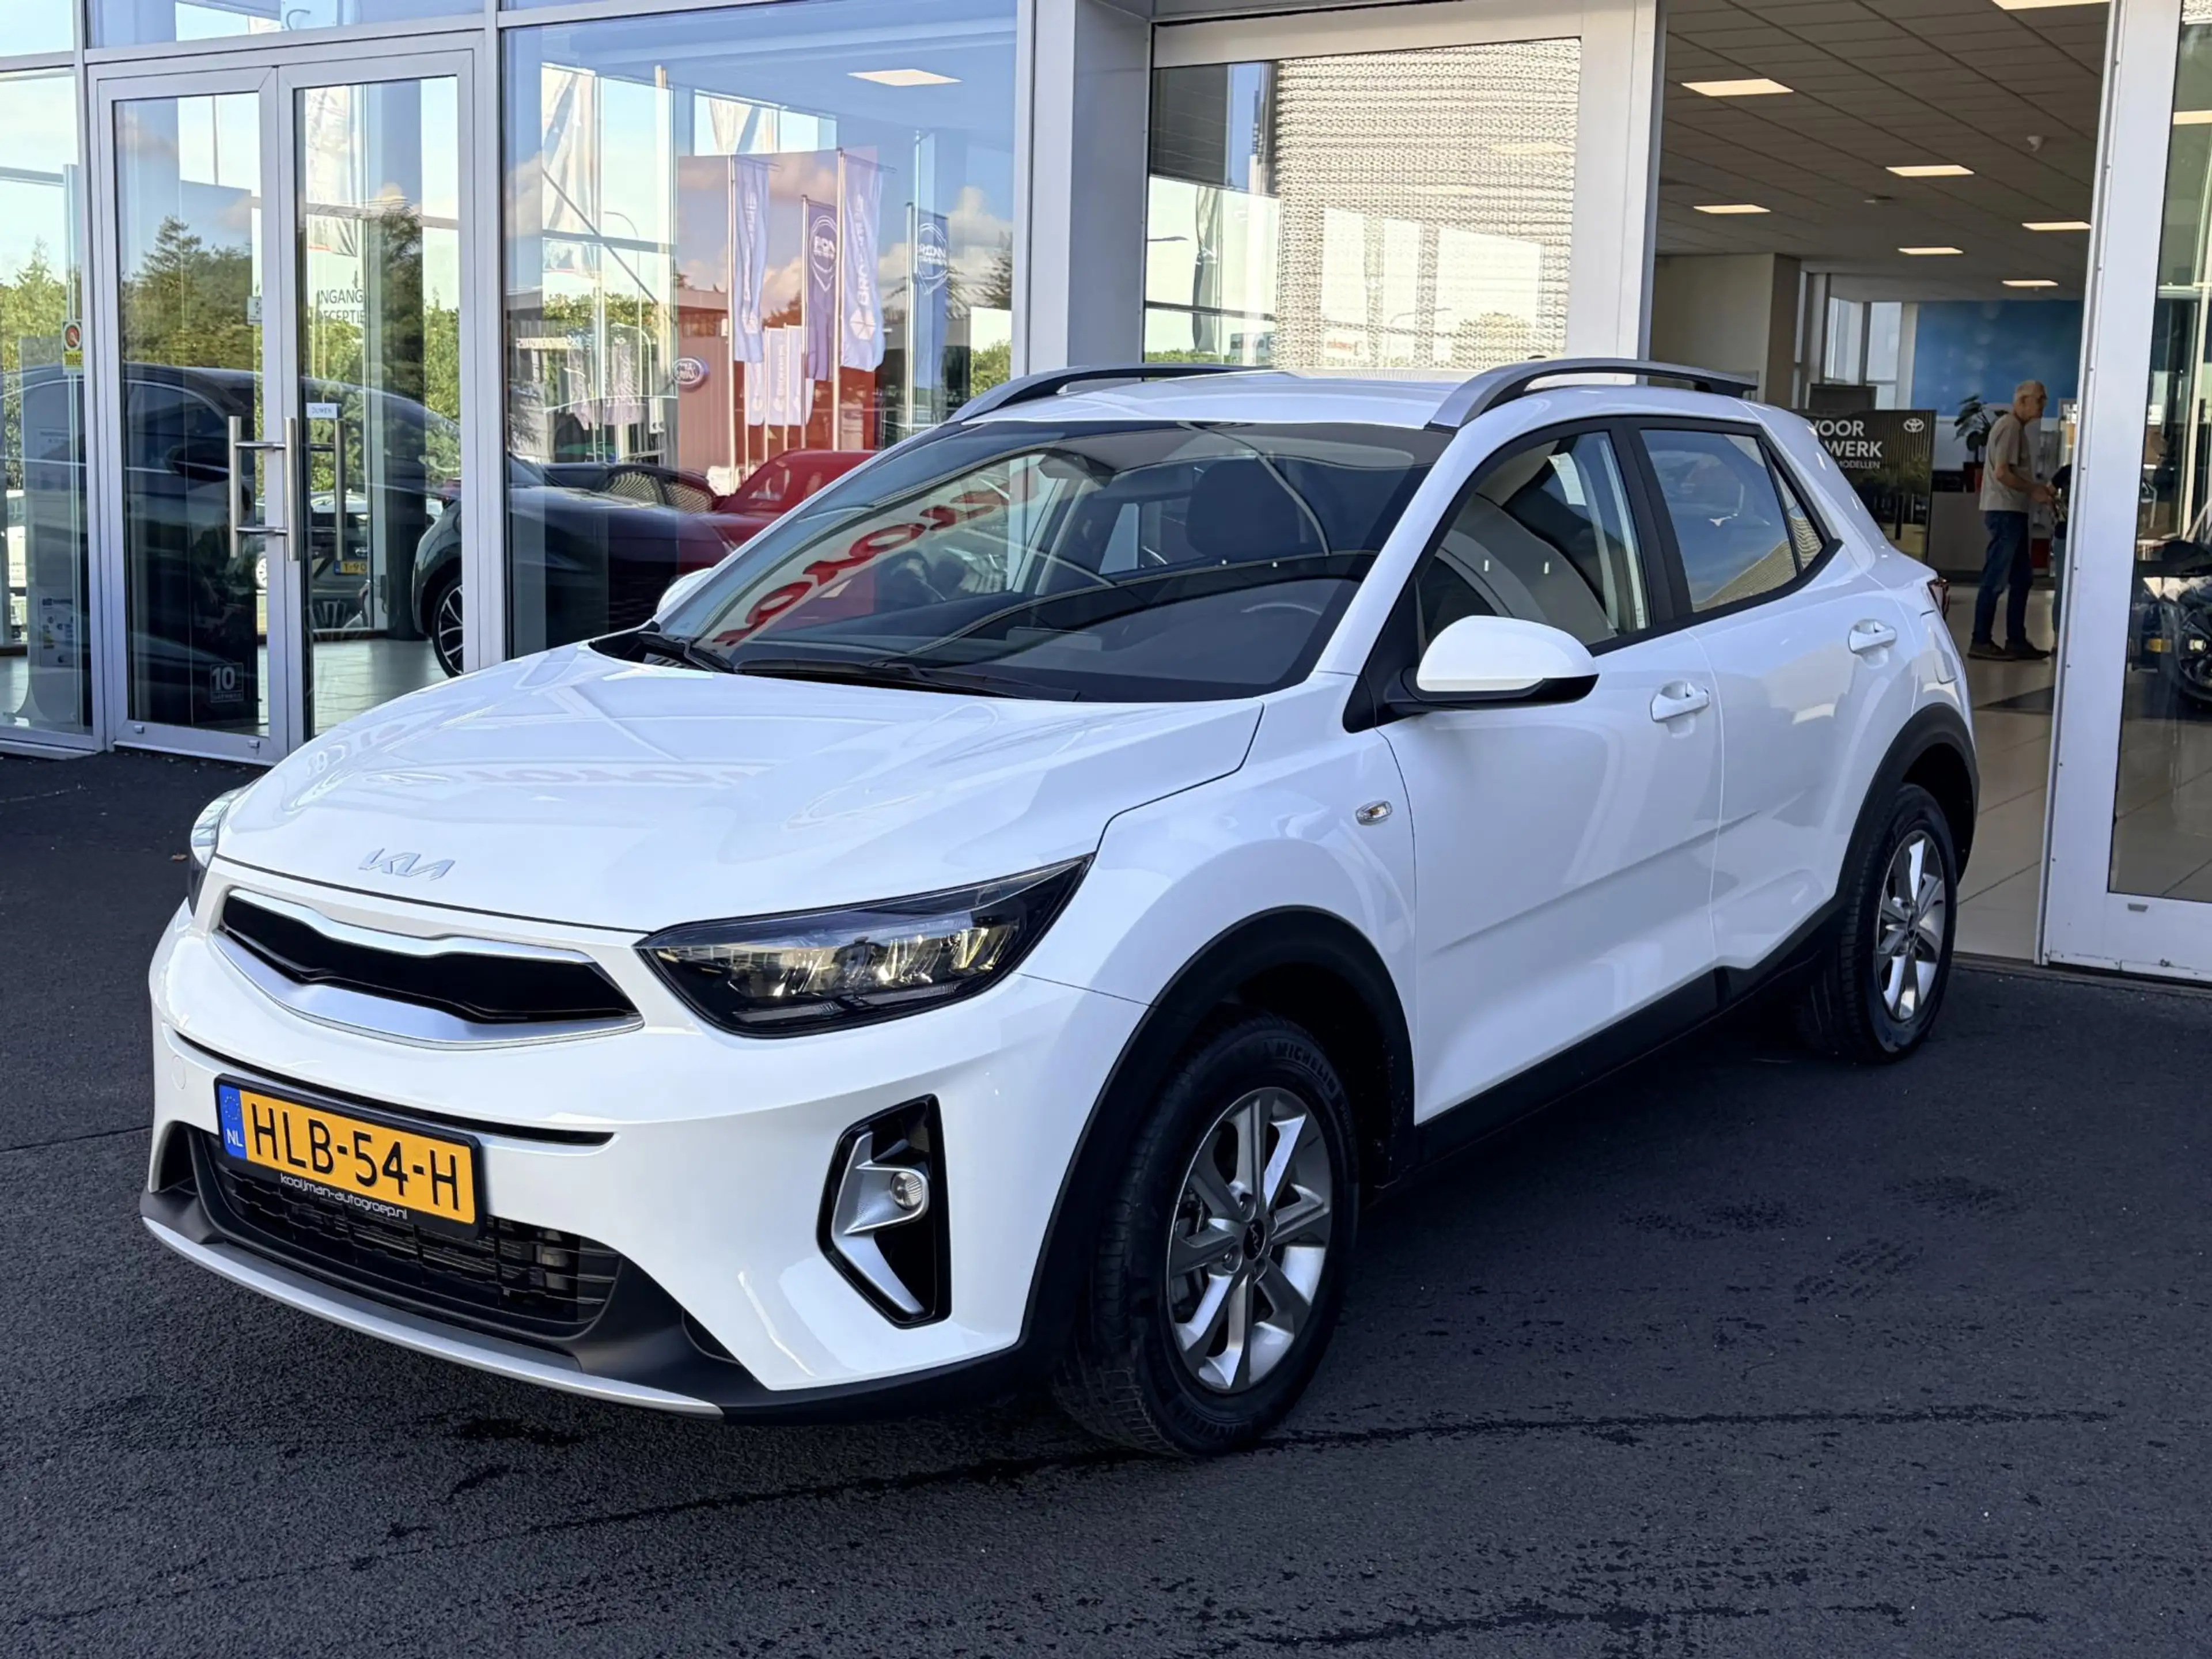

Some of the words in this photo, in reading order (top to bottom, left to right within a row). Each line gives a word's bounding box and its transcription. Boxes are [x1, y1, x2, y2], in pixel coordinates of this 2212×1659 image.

[317, 289, 364, 304] INGANG
[1825, 441, 1883, 457] WERK
[212, 666, 236, 691] 10
[357, 848, 456, 881] KIA
[226, 1127, 243, 1147] NL
[251, 1103, 459, 1211] HLB-54-H
[280, 1173, 408, 1219] kooijman-autogroep.nl
